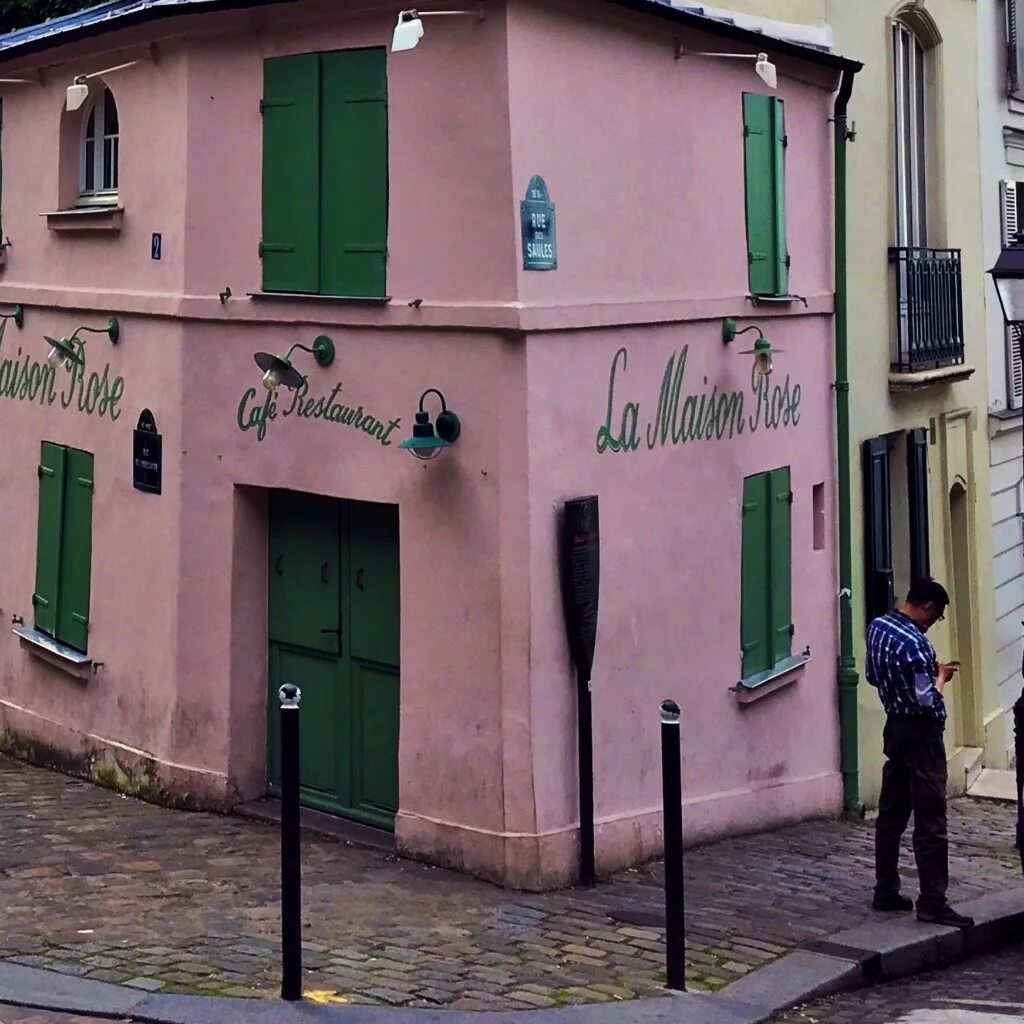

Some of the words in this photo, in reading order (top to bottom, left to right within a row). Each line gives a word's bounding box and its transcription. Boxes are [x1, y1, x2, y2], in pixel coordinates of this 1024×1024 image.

[527, 242, 553, 258] SAULES
[531, 212, 546, 229] RUE
[61, 336, 124, 421] Rose
[237, 387, 278, 442] Café
[283, 375, 403, 446] Restaurant
[596, 347, 641, 454] La
[647, 344, 745, 451] Maison
[749, 360, 802, 432] Rose
